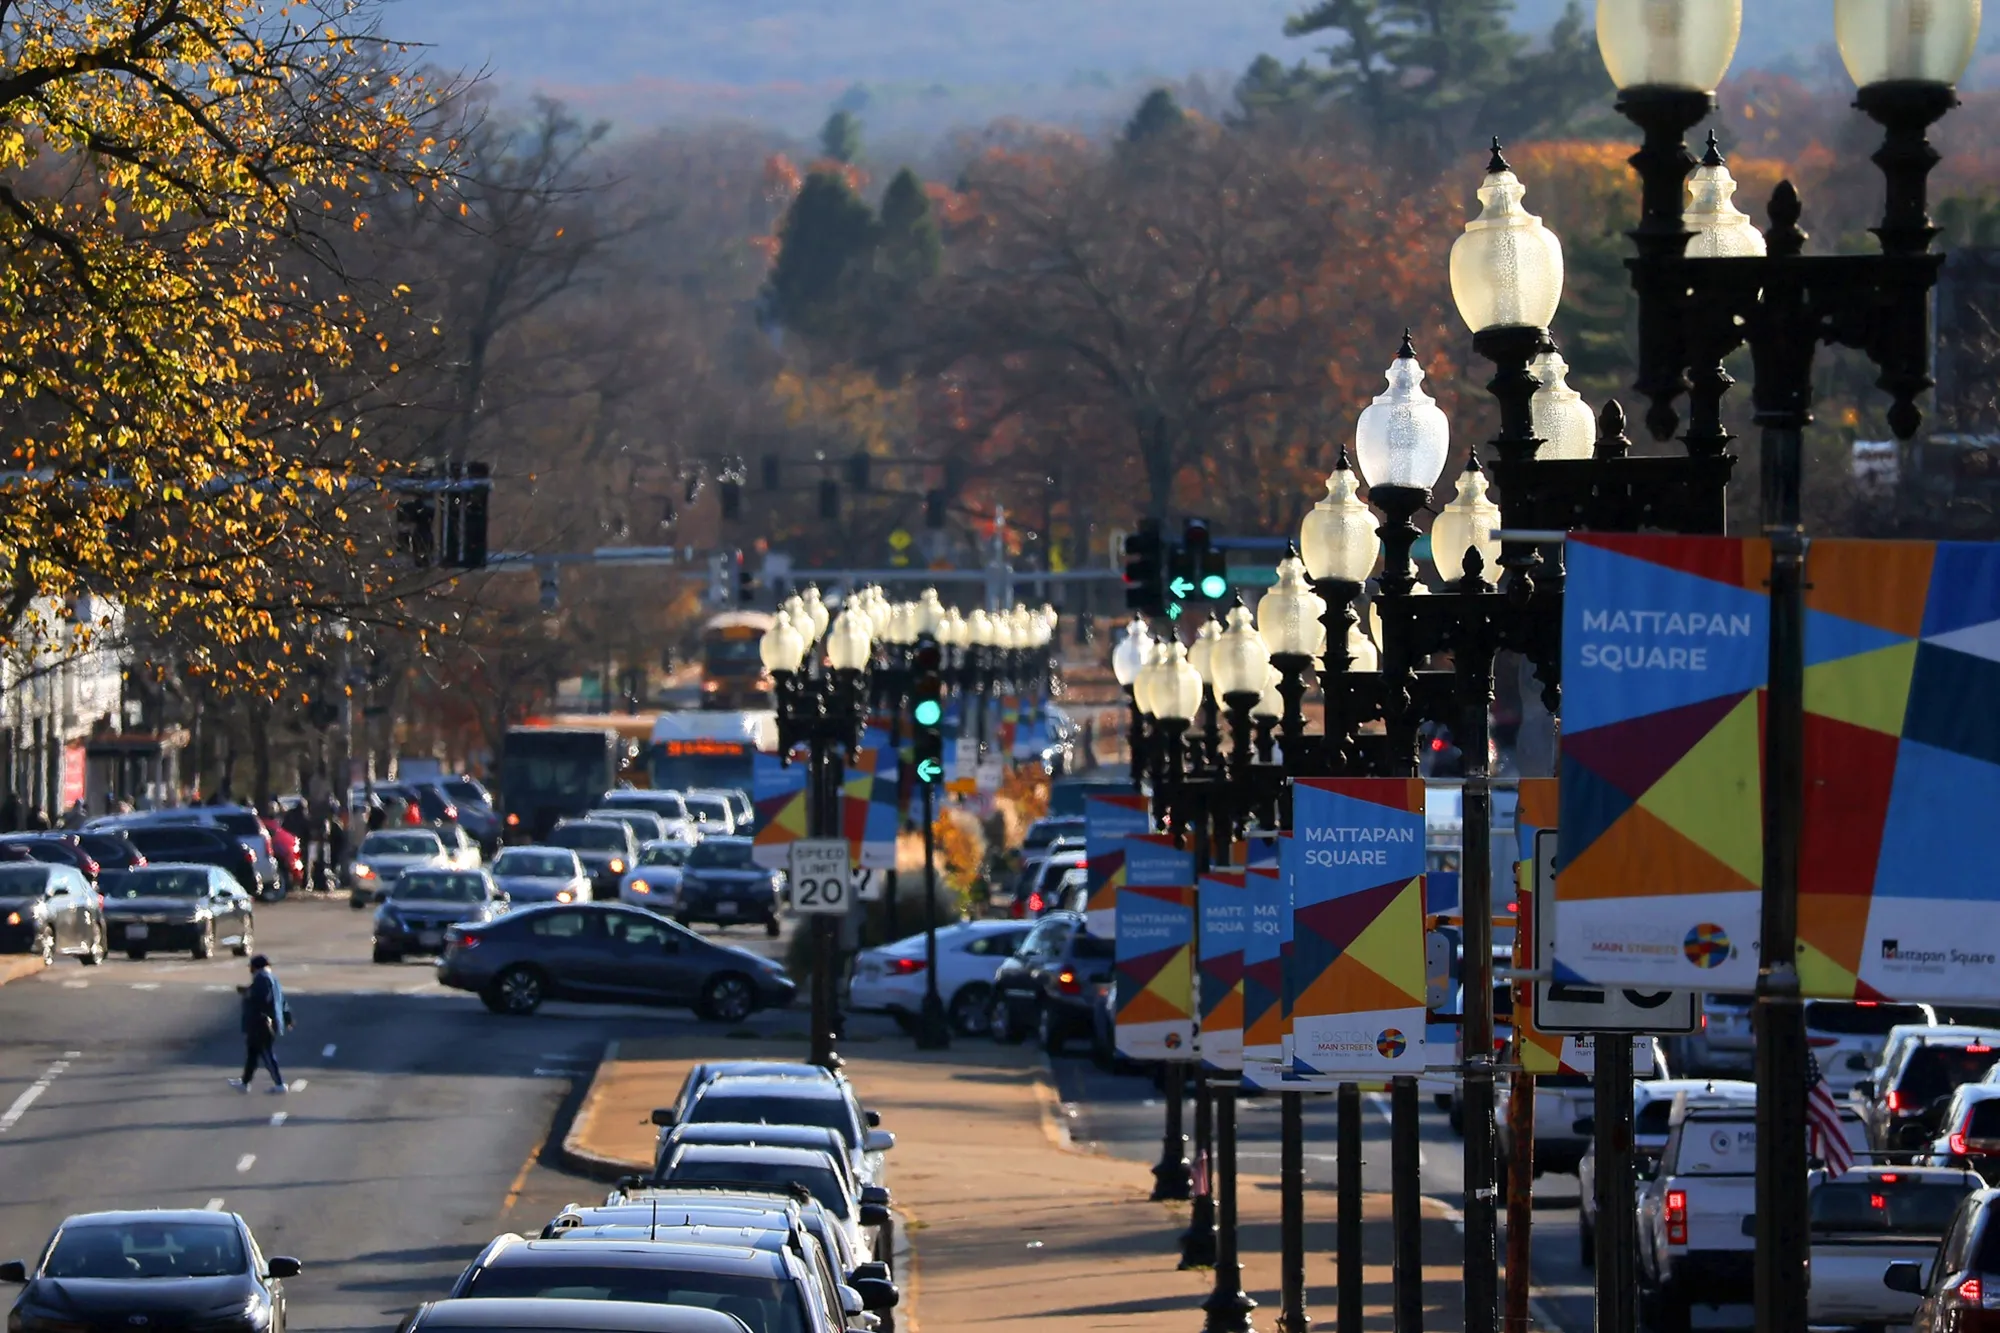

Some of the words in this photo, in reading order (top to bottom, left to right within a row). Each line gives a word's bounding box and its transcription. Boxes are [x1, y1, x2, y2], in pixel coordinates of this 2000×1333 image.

[1582, 608, 1751, 637] MATTAPAN
[1579, 644, 1708, 673] SQUARE
[1305, 827, 1414, 842] MATTAPAN
[797, 848, 844, 860] SPEED
[1305, 849, 1387, 868] SQUARE
[801, 863, 839, 875] LIMIT
[799, 878, 843, 905] 20
[1206, 906, 1245, 917] MATT
[1122, 914, 1187, 924] MATTAPAN
[1591, 942, 1624, 952] MAIN
[1627, 944, 1679, 956] STREETS
[1882, 939, 1946, 964] Mattapan
[1950, 949, 1996, 966] Square
[1311, 1031, 1374, 1043] BOSTON
[1317, 1043, 1339, 1051] MAIN
[1340, 1043, 1374, 1051] STREETS
